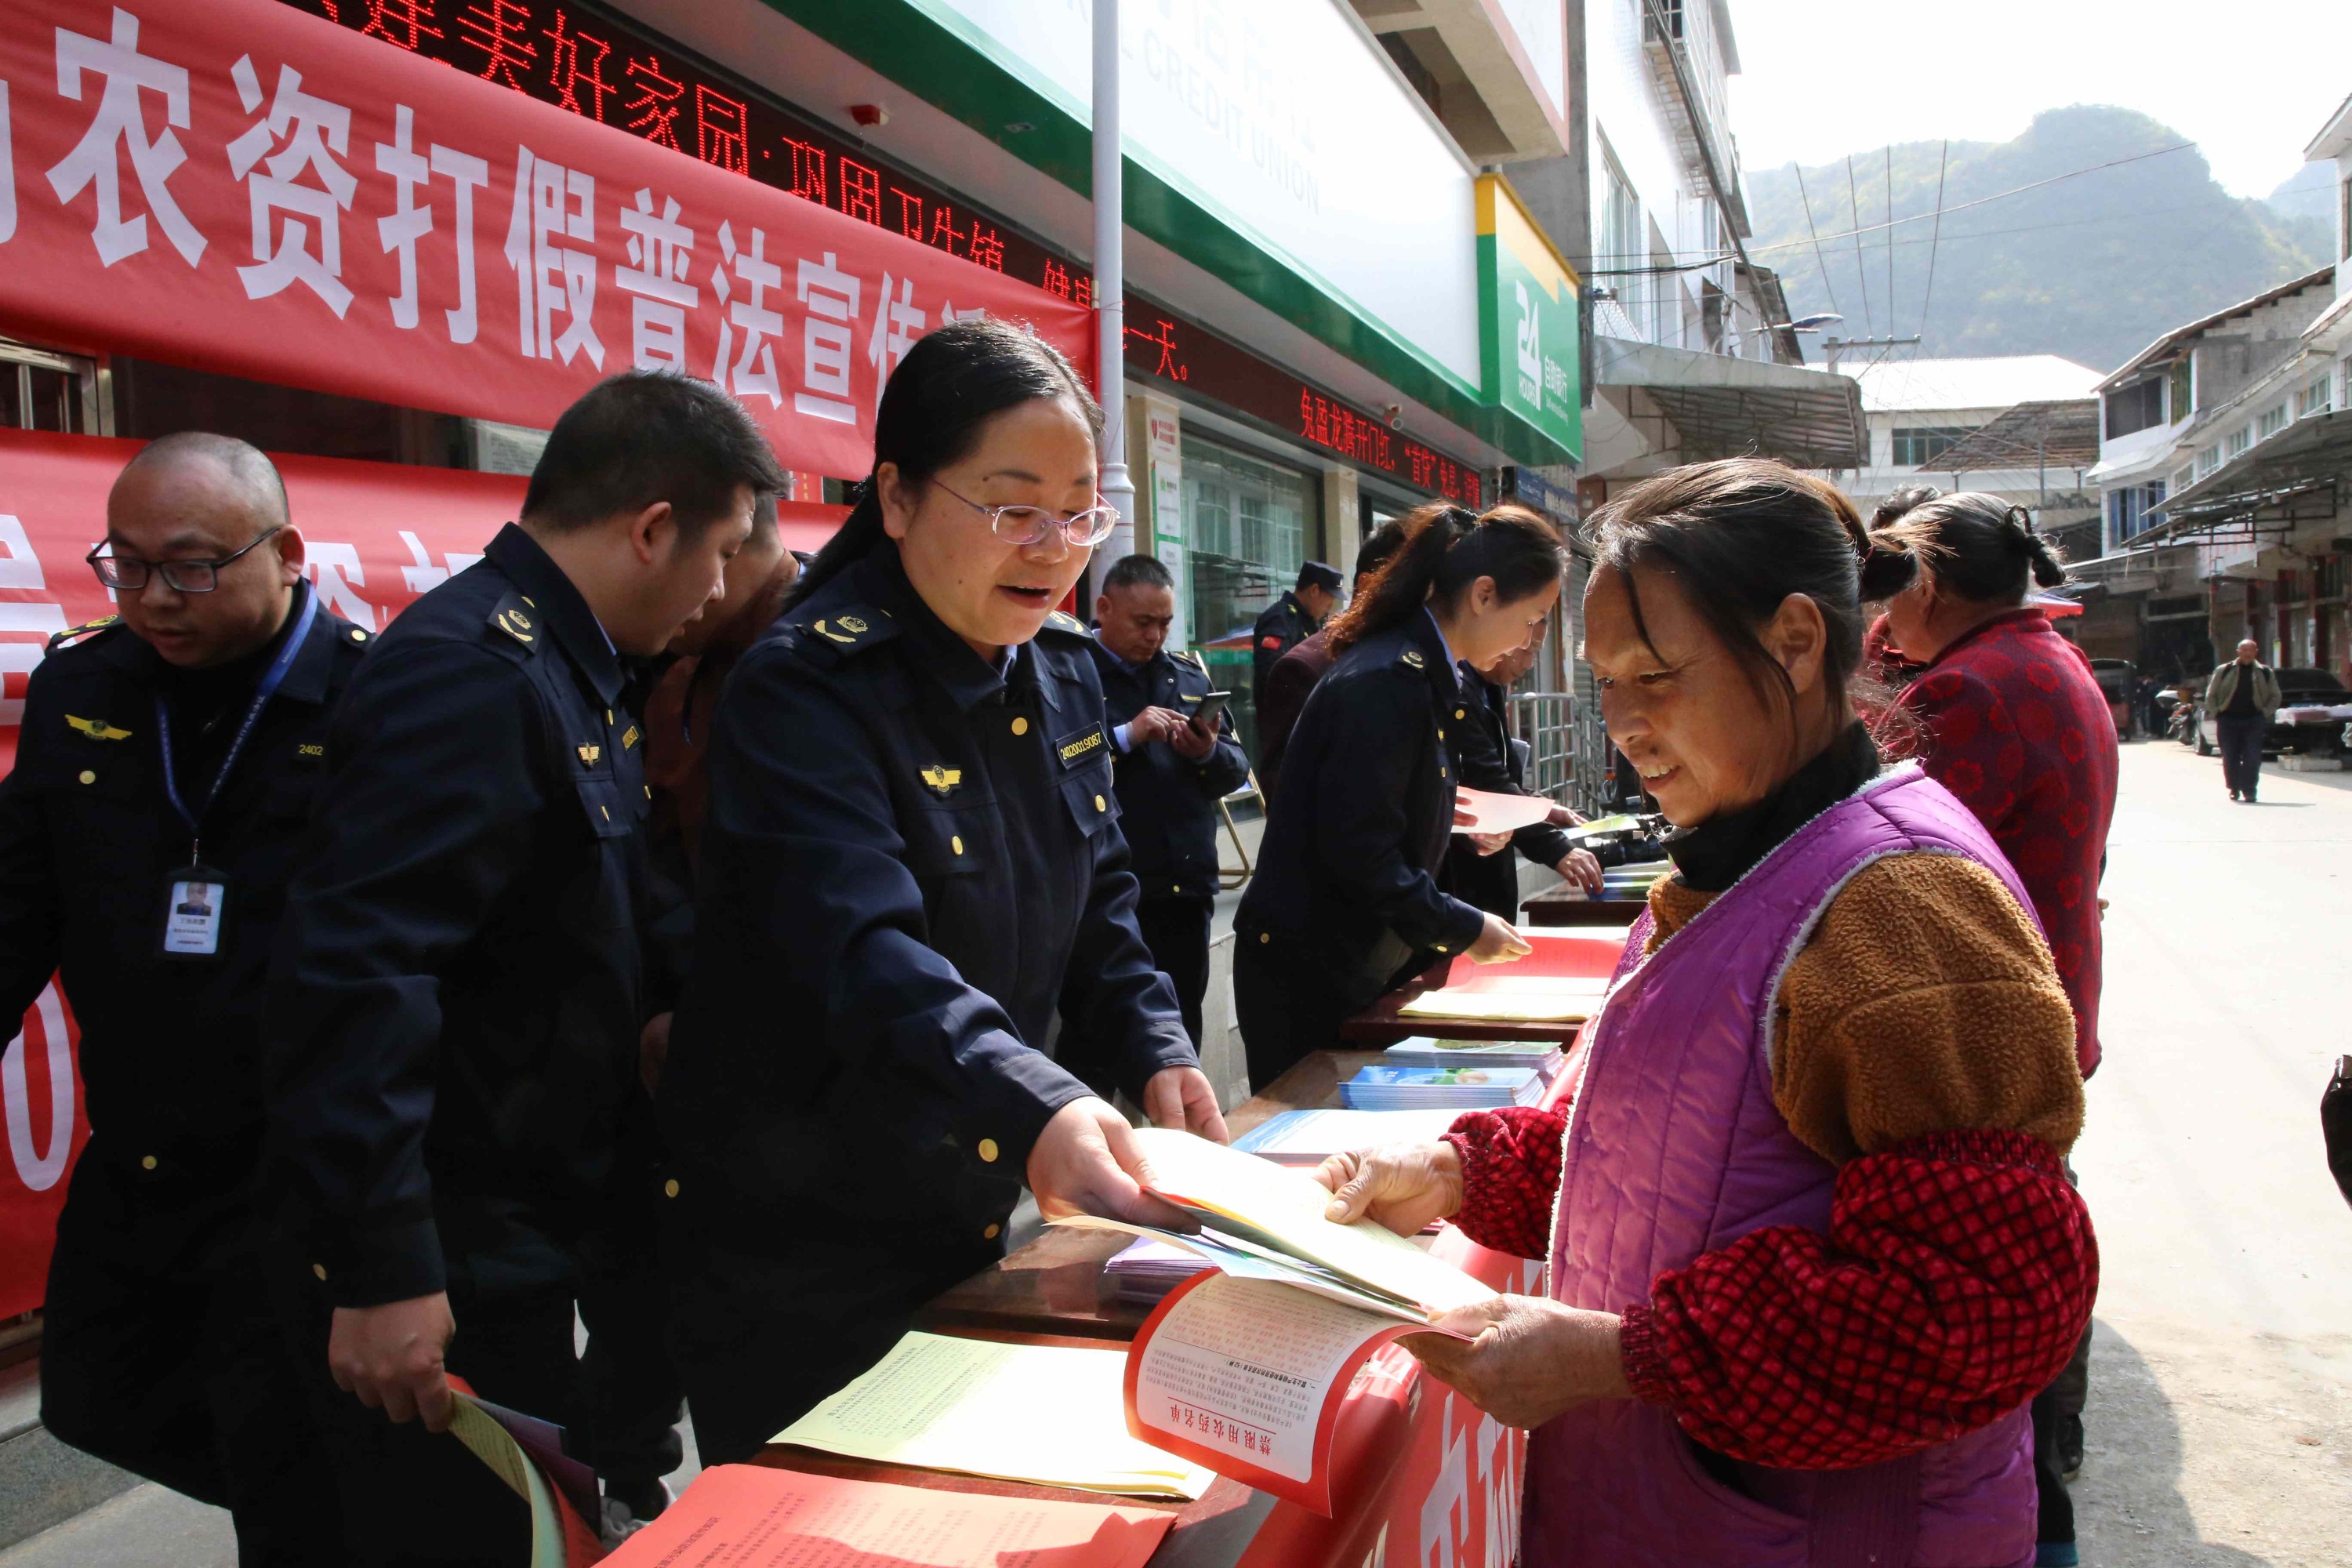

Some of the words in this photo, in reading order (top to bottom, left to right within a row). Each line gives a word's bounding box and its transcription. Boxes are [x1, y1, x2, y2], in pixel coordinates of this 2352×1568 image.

[1143, 27, 1244, 151] CREDIT
[1251, 120, 1319, 216] UNION
[0, 5, 985, 423] 农资打假普法宣传
[1515, 279, 1542, 412] 24
[299, 744, 323, 756] 2402
[1061, 732, 1102, 760] 24020019087
[1170, 1403, 1271, 1456] 禁限用农药名单
